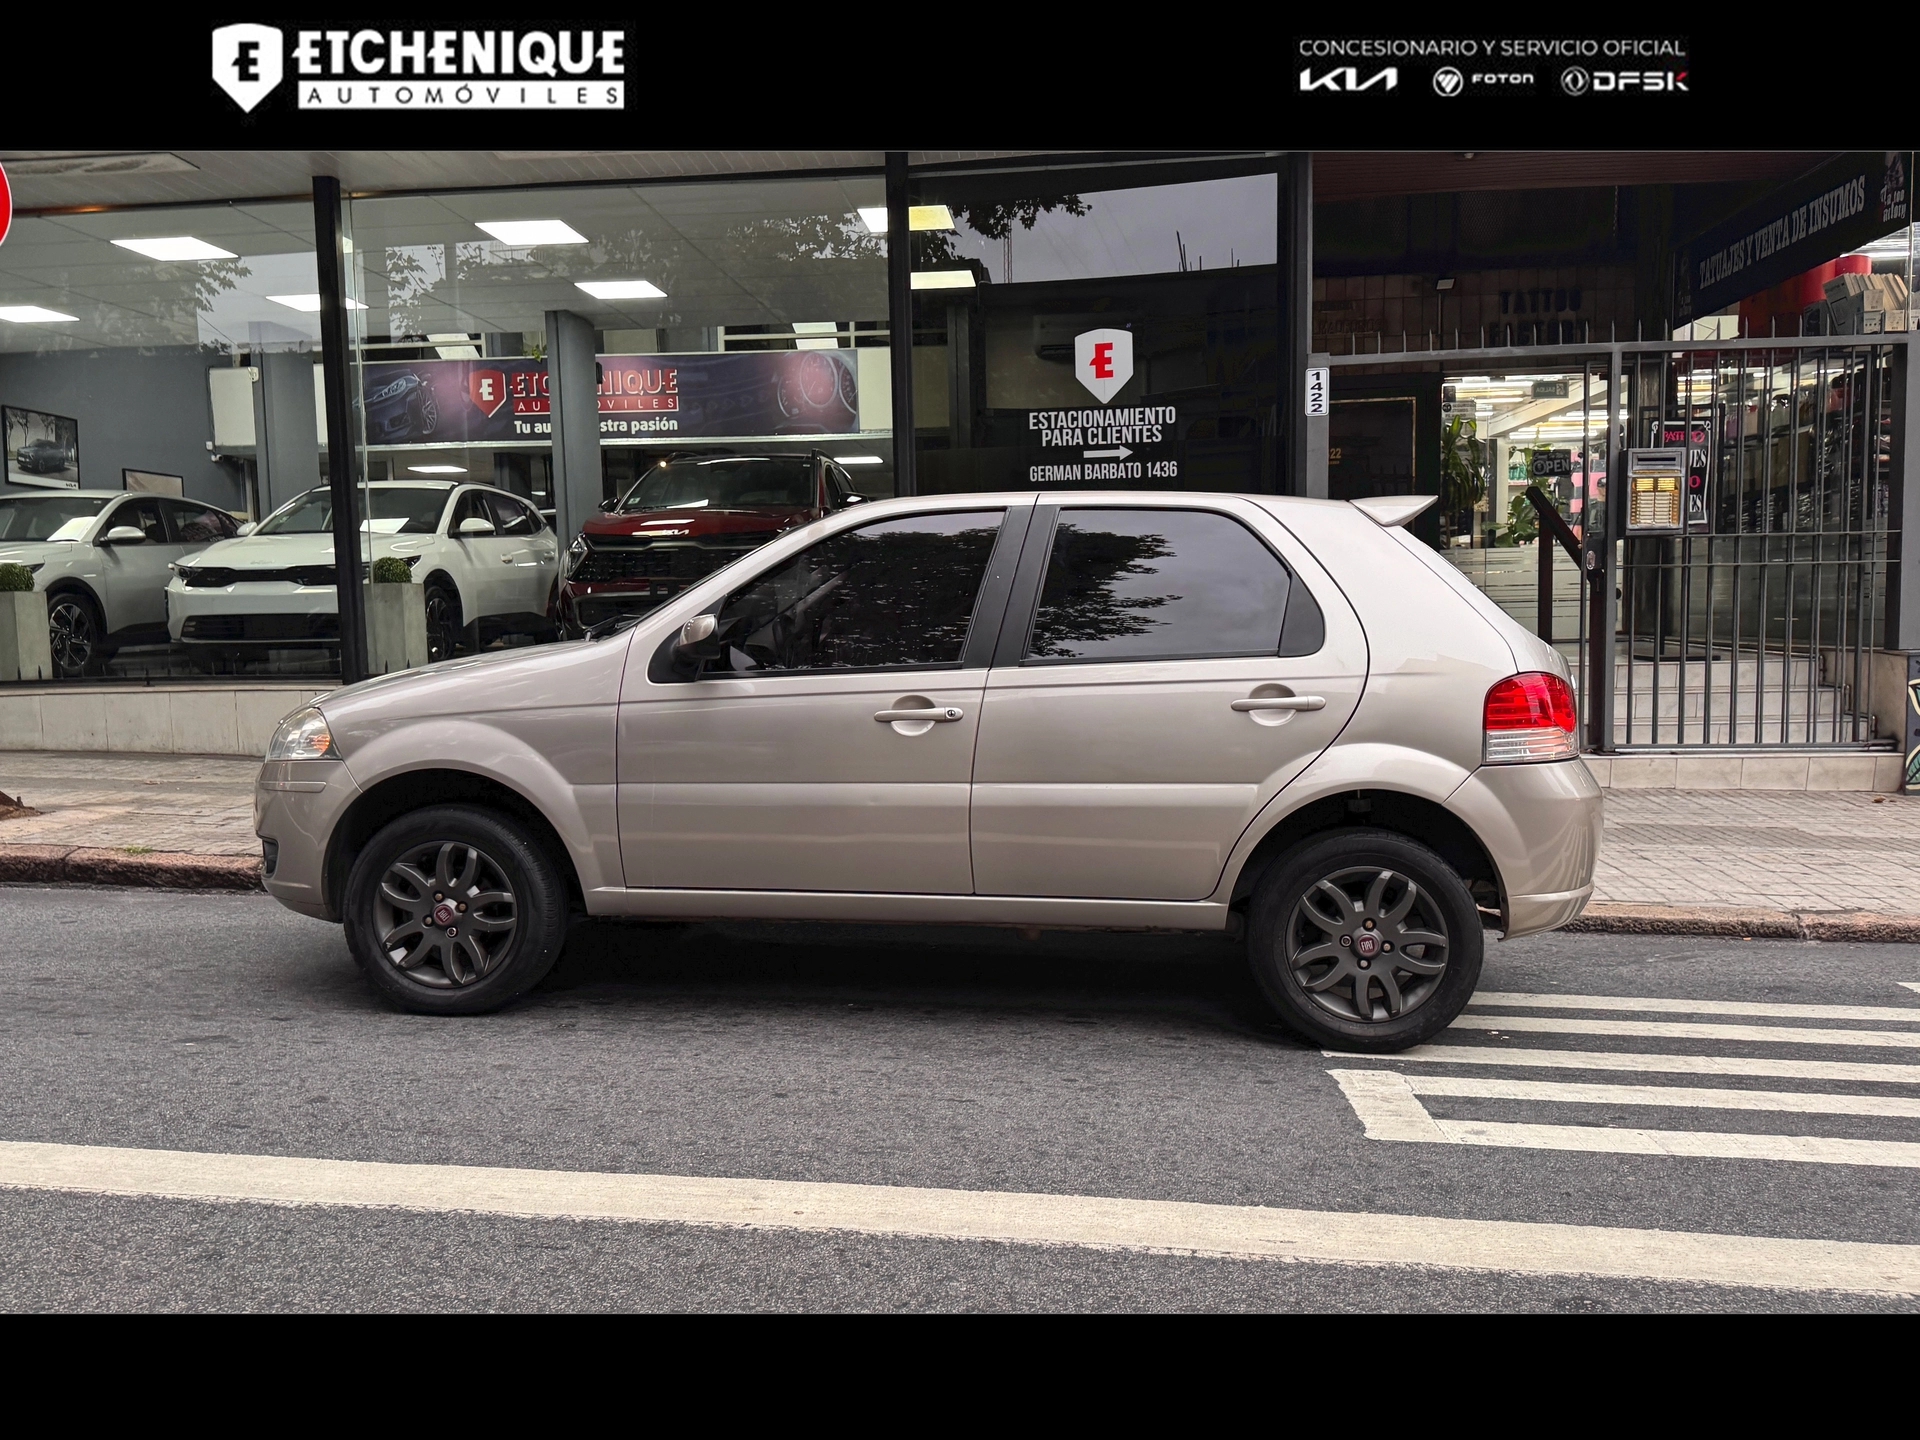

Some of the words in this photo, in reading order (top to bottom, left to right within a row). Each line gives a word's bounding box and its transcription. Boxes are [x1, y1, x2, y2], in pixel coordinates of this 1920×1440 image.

[1699, 239, 1745, 290] TATUAJES
[1746, 234, 1755, 266] Y
[1755, 214, 1790, 261] VENTA
[1791, 205, 1807, 244] DE
[1808, 175, 1866, 234] INSUMOS
[1500, 285, 1582, 315] TATTOO
[509, 369, 679, 397] ETCNIQUE
[1310, 371, 1323, 413] 1422
[514, 420, 531, 434] Tu
[630, 416, 678, 435] pasión
[1029, 405, 1176, 430] ESTACIONAMIENTO
[1042, 428, 1083, 447] PARA
[1088, 424, 1163, 445] CLIENTES
[1029, 464, 1081, 482] GERMAN
[1084, 462, 1142, 480] BARBATO
[1146, 460, 1178, 478] 1436
[1533, 458, 1570, 475] OPEN
[1360, 939, 1374, 952] FIAT
